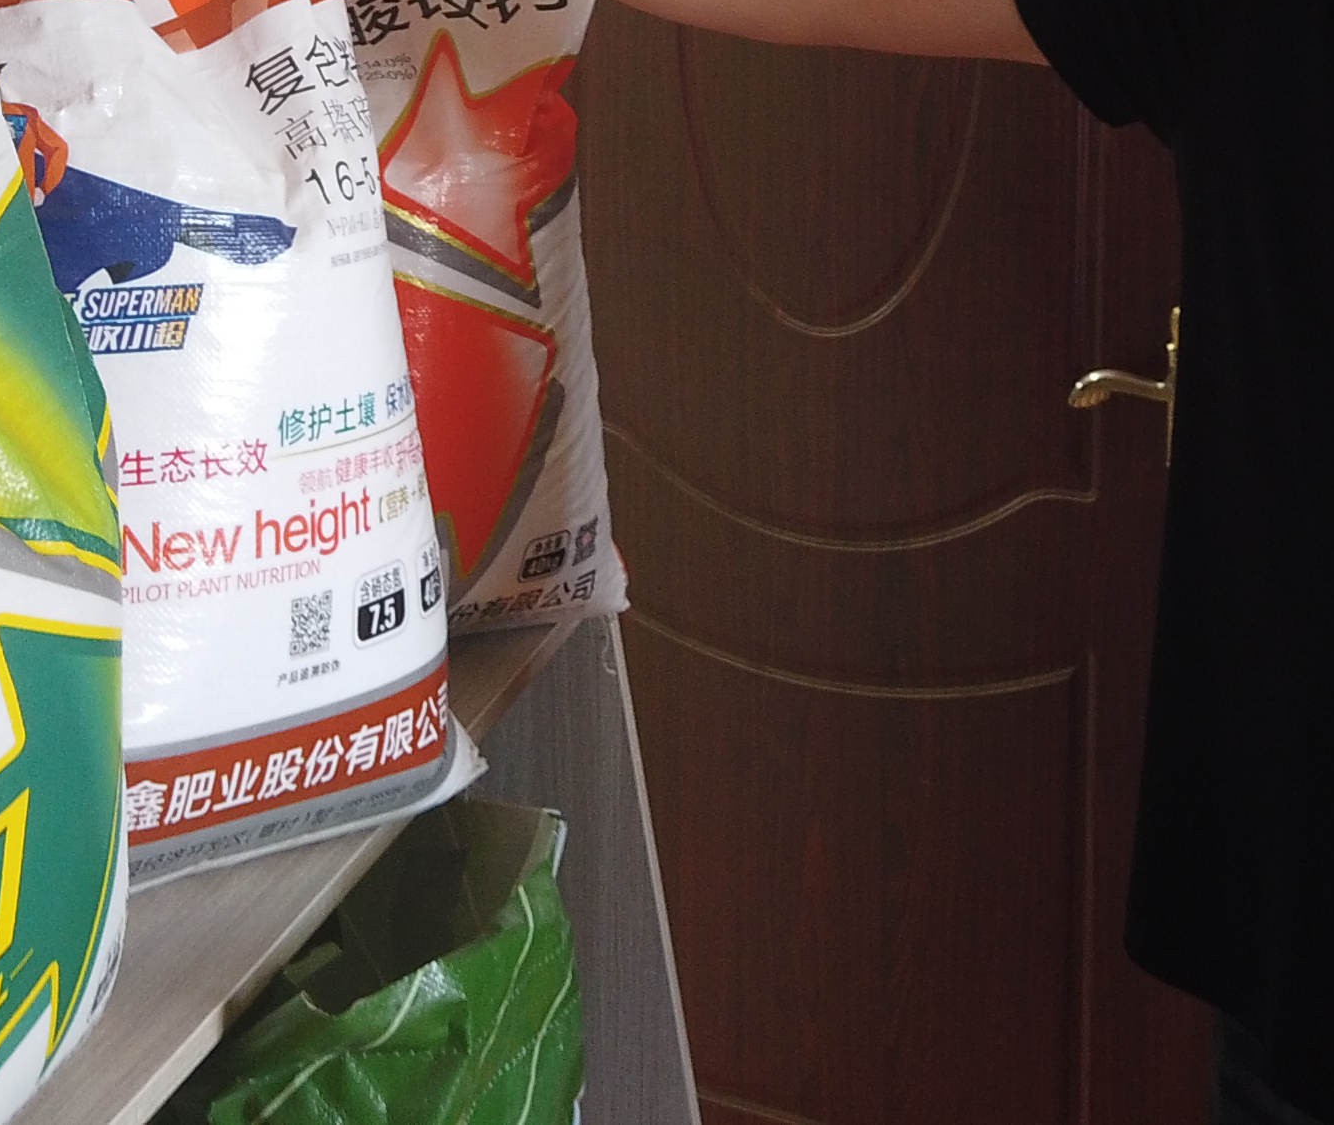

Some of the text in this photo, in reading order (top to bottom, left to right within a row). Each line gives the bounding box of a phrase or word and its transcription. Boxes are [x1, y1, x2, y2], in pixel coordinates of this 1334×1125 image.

[84, 287, 201, 318] SUPERMAN
[82, 321, 187, 352] 收小超
[278, 392, 376, 447] 修护土壤
[119, 438, 269, 488] 生态长效
[122, 486, 372, 575] New height
[237, 559, 322, 592] NUTRITION
[369, 597, 397, 635] 7.5
[125, 681, 449, 833] 鑫肥业股份有限公司
